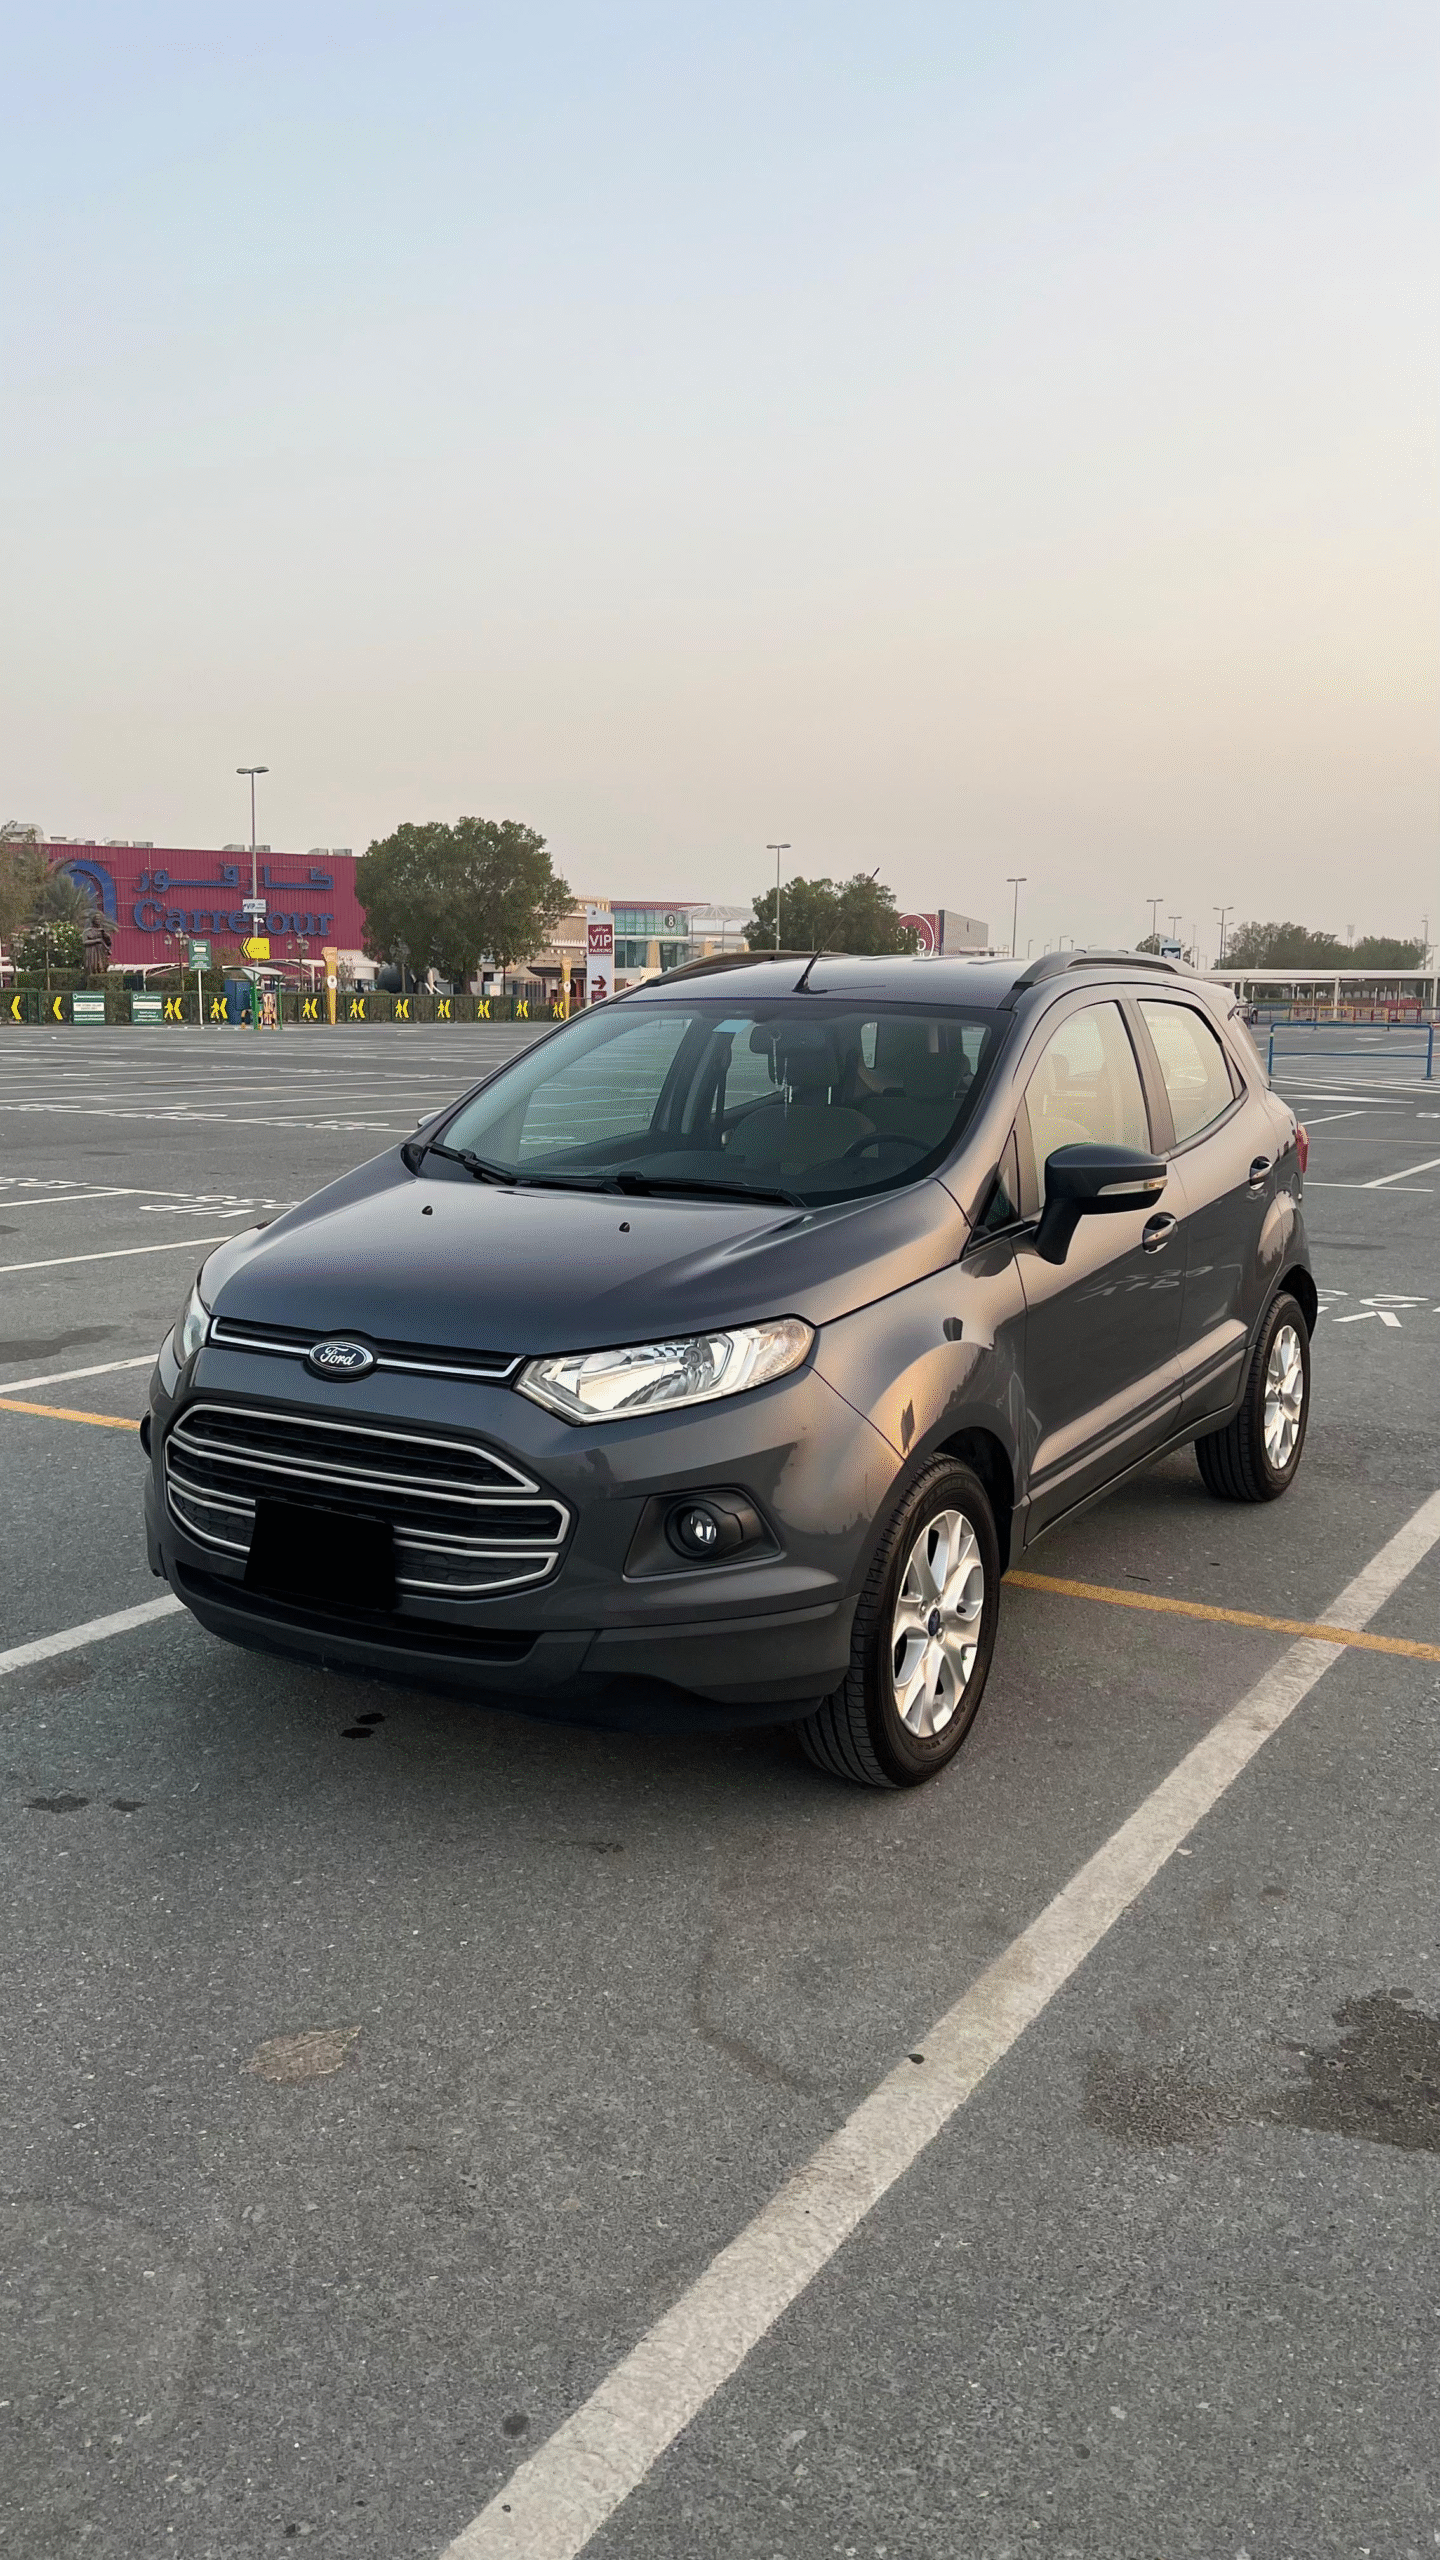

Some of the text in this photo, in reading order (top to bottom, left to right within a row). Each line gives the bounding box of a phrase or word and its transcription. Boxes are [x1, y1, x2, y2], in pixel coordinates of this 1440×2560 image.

[133, 898, 335, 937] Carreour
[589, 934, 612, 947] VIP
[138, 1204, 256, 1219] VIP
[320, 1346, 357, 1365] Ford
